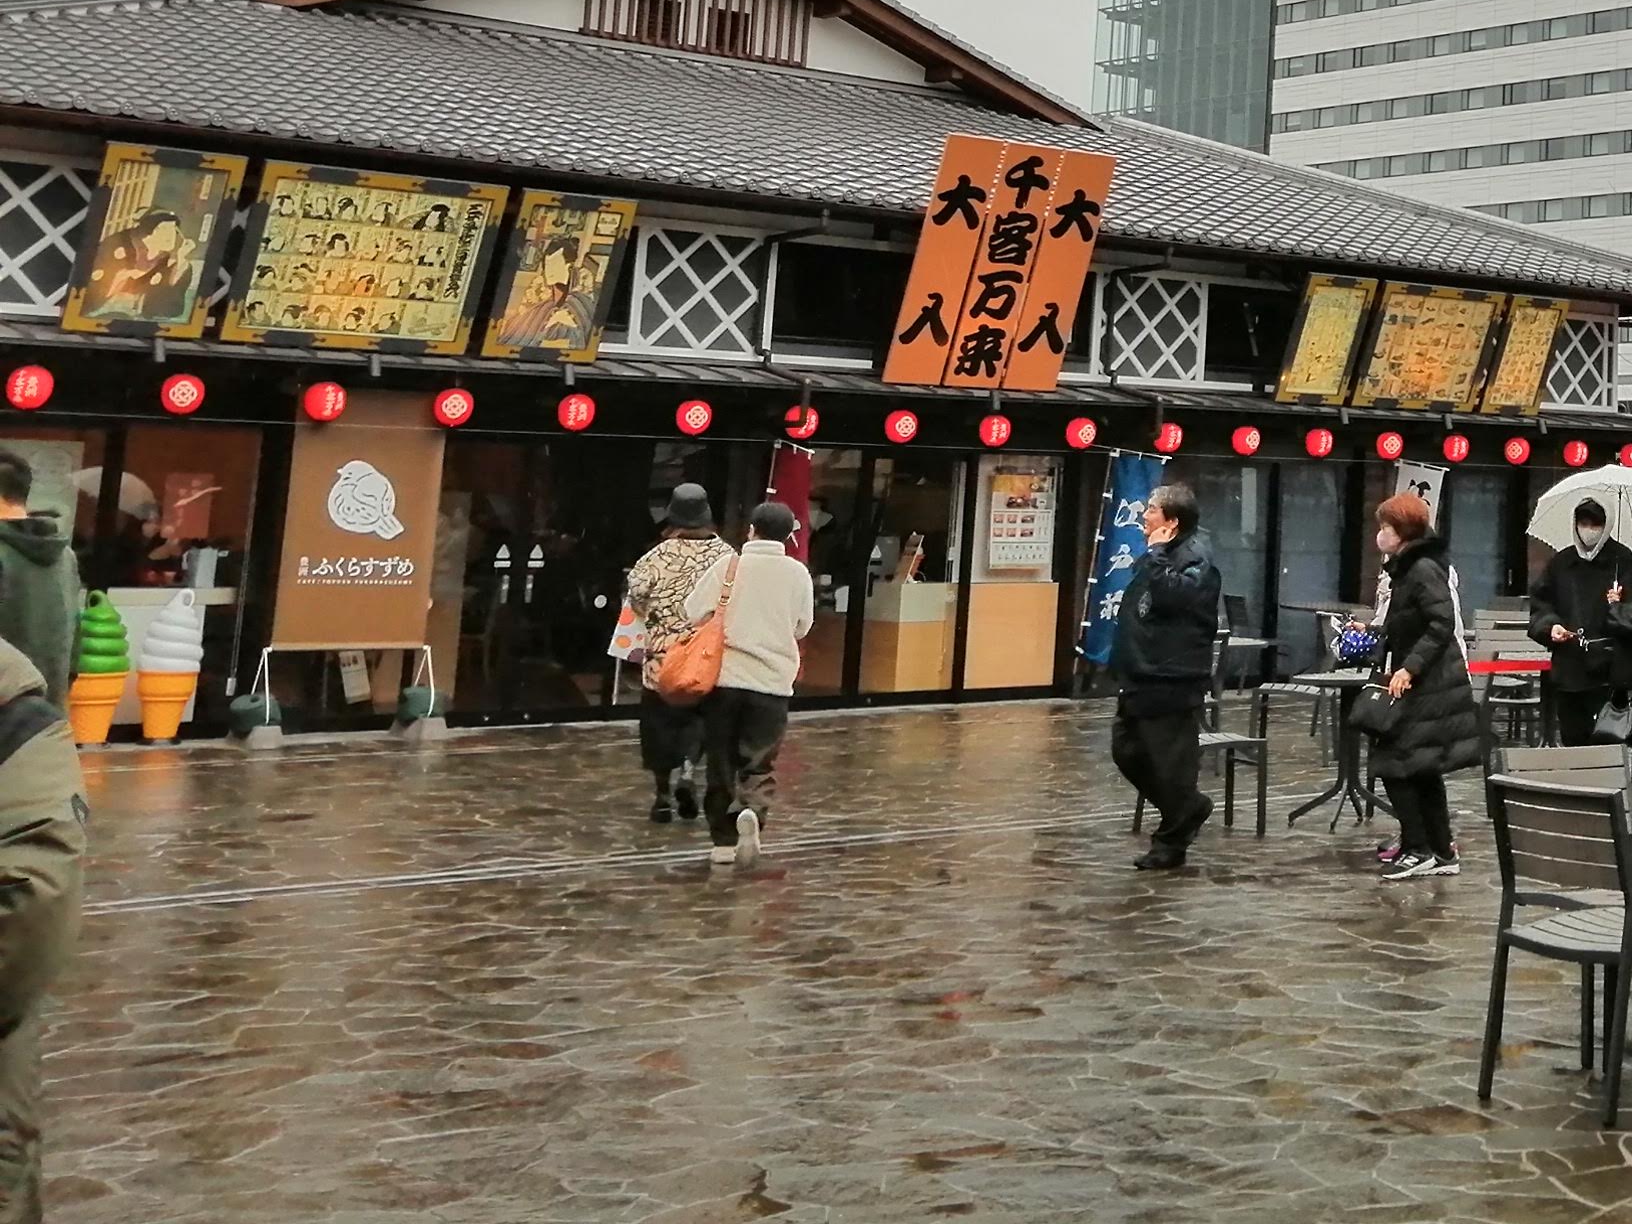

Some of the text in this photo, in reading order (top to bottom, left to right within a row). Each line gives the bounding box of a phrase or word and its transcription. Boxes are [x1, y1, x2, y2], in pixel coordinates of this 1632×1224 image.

[954, 155, 1050, 378] 千客万来
[312, 556, 414, 577] ふくらすずめ
